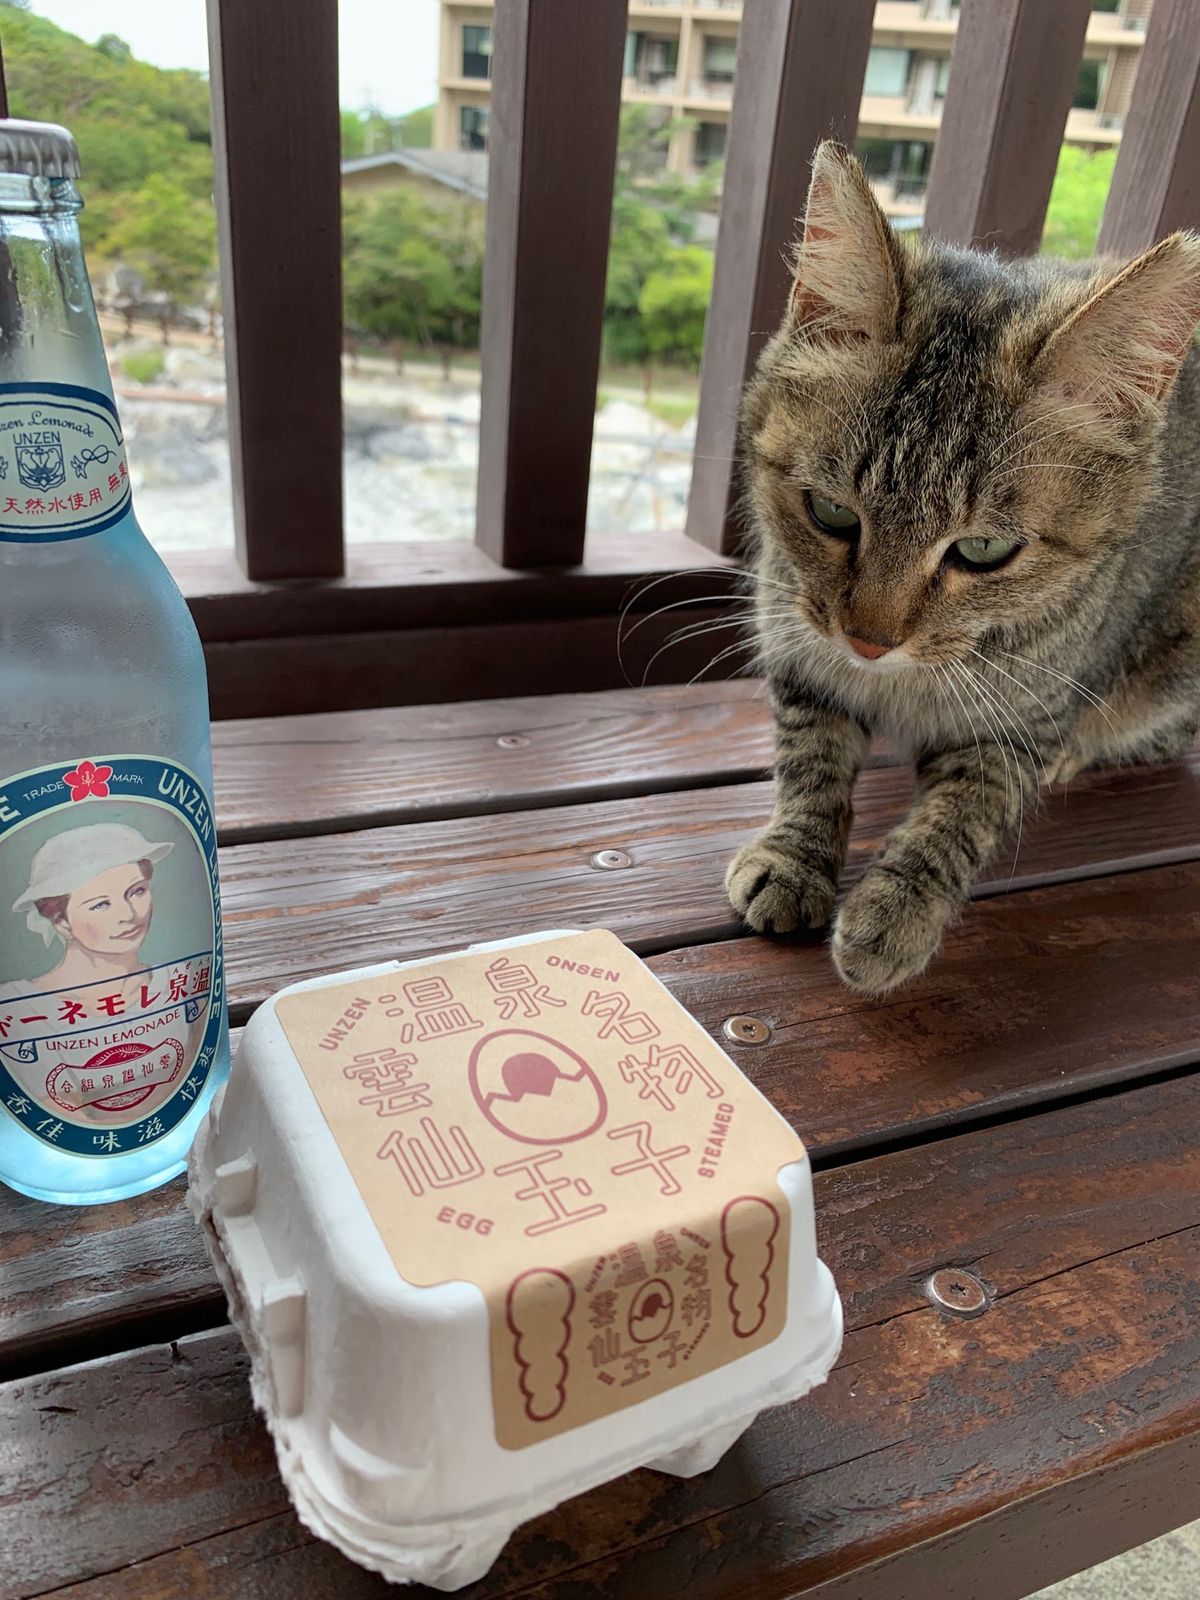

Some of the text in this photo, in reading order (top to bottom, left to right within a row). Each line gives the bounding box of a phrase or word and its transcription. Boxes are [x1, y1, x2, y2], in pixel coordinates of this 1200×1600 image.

[13, 431, 61, 446] UNZEN
[27, 410, 94, 439] Lemonade
[3, 461, 128, 514] 天然水使用 無果
[23, 774, 144, 801] TRADE MARK
[158, 768, 223, 1020] UNZEN LEMONADE
[545, 954, 621, 983] ONSEN
[46, 1008, 181, 1051] UNZEN LEMONADE
[319, 996, 372, 1052] UNZEN
[435, 1102, 735, 1236] STEAMED EGG
